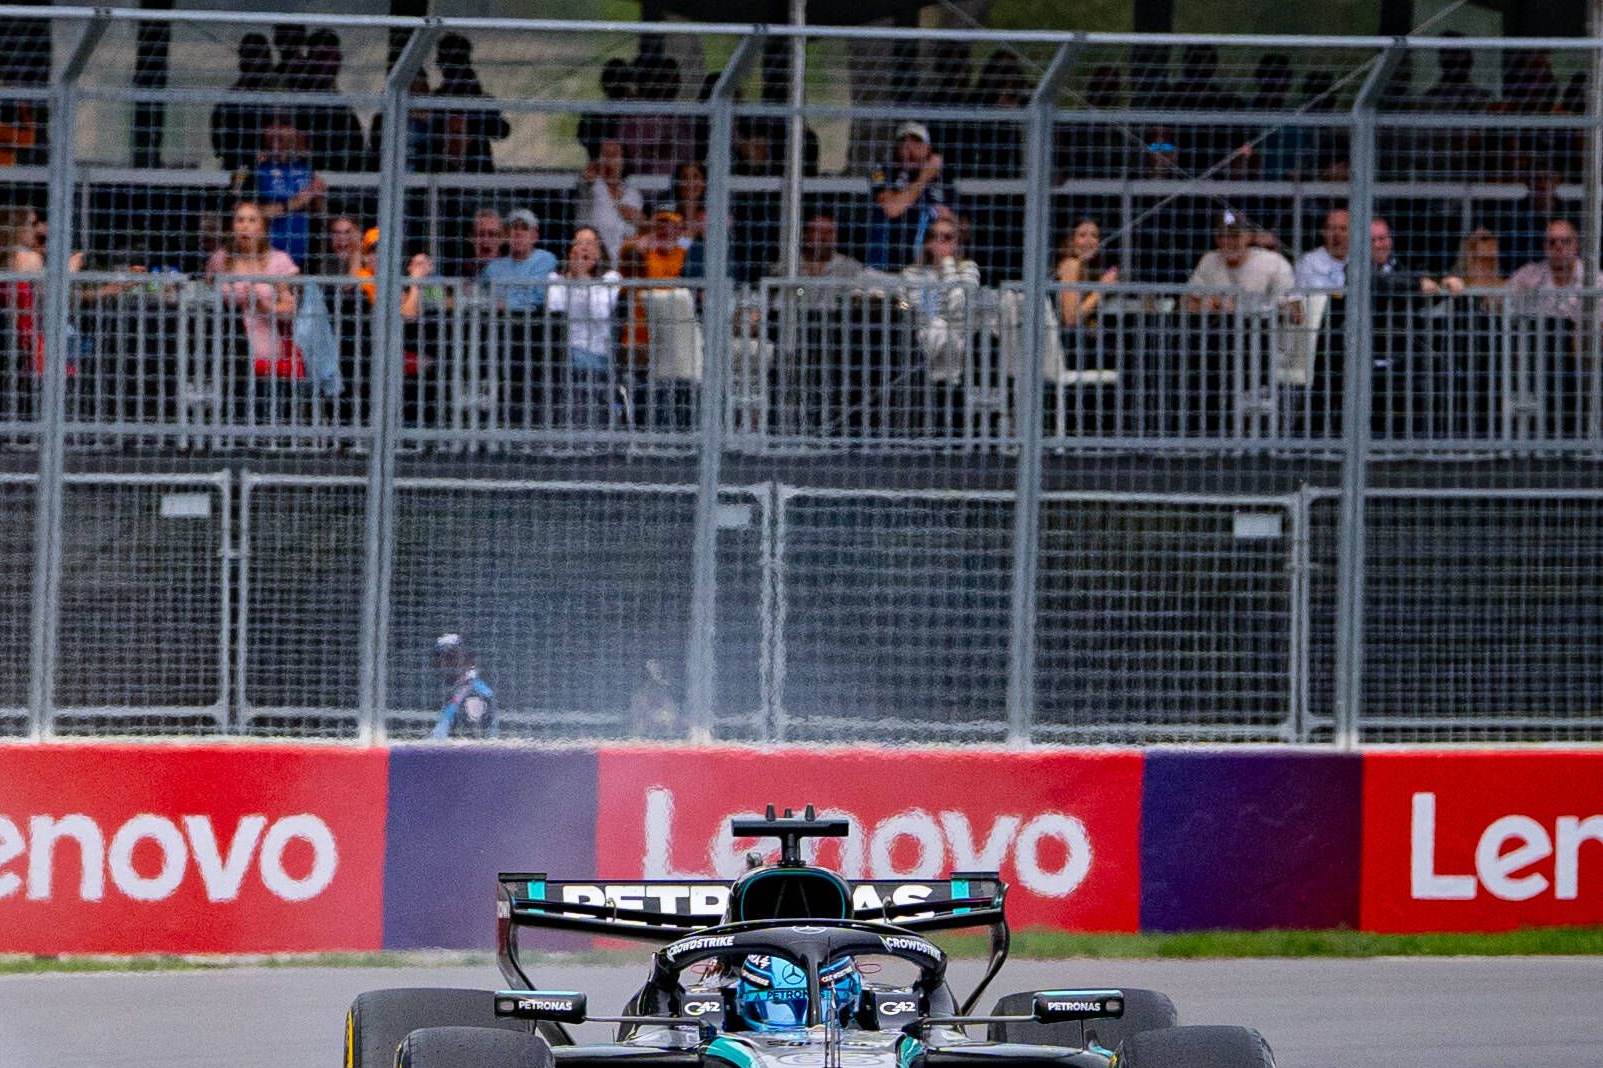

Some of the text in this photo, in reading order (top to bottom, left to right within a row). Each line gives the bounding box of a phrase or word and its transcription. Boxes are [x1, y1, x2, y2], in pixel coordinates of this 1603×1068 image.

[1411, 791, 1603, 901] Len
[562, 885, 934, 928] PETRAS
[518, 1000, 573, 1012] PETRONAS
[1048, 1001, 1101, 1012] PETRONAS
